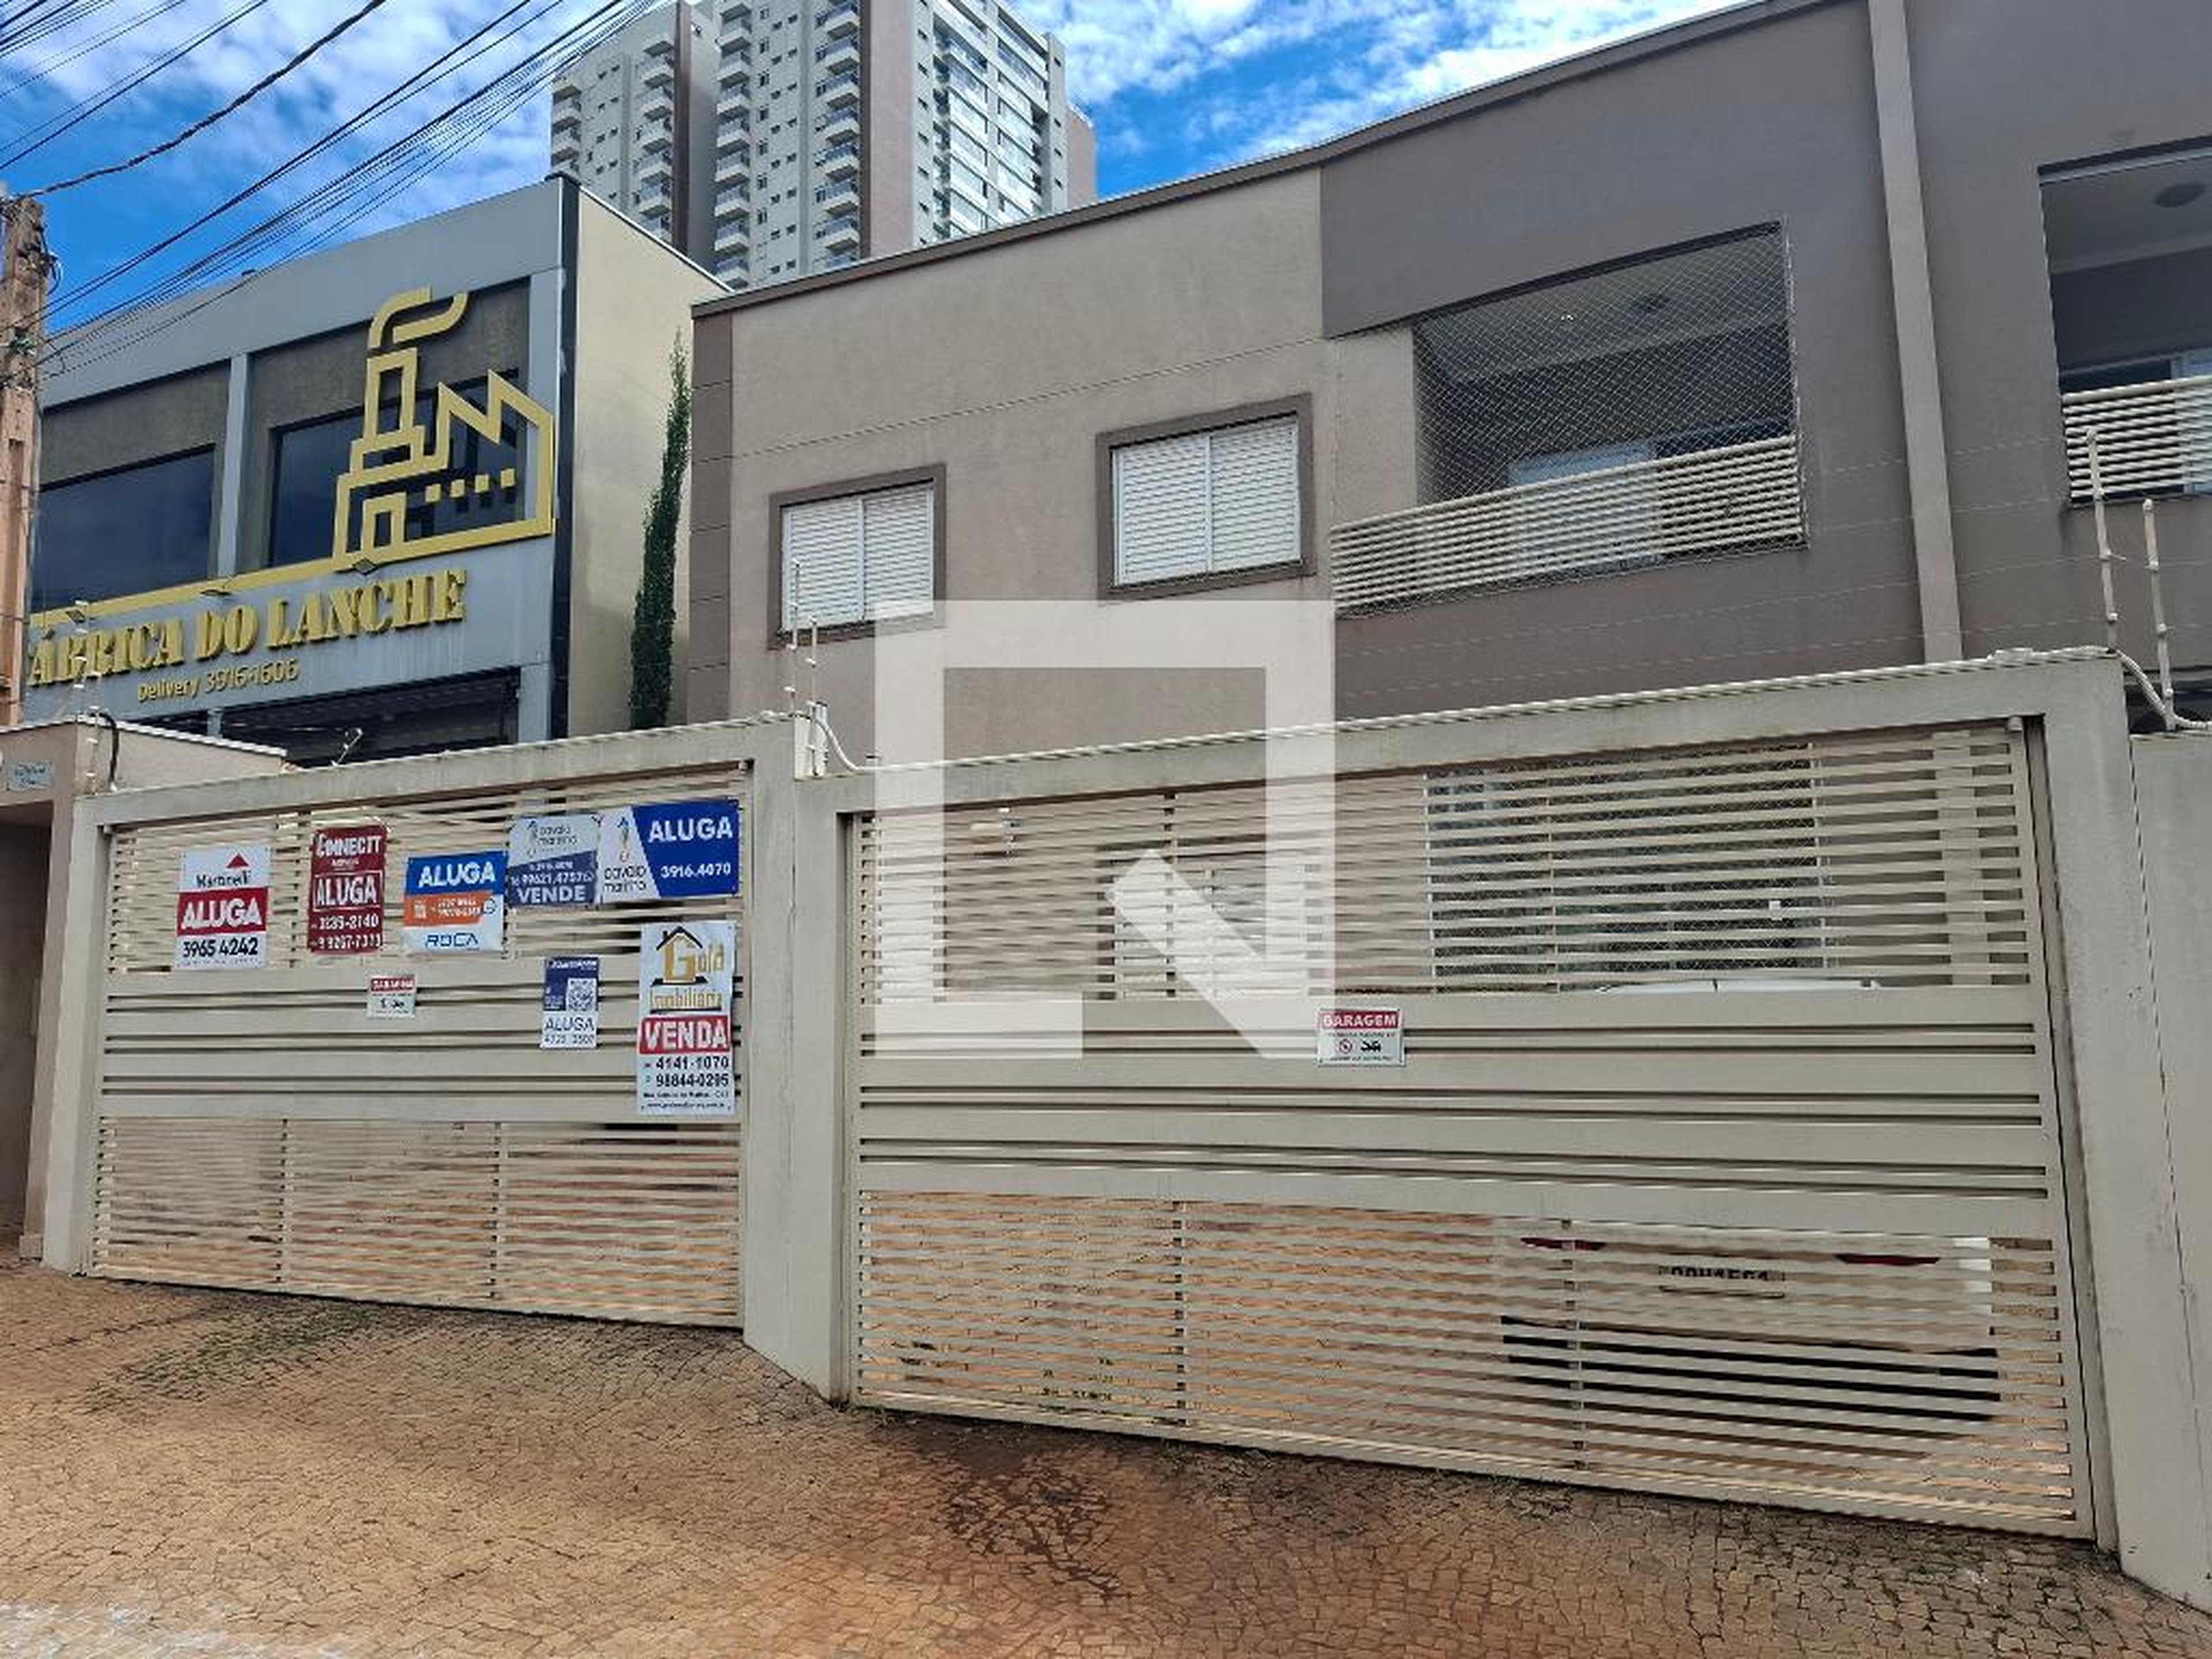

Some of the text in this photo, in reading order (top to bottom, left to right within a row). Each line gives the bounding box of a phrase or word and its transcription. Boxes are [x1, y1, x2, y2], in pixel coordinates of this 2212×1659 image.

[196, 602, 257, 661] DO
[267, 570, 467, 649] LANCHE
[138, 677, 199, 702] Delivery
[648, 816, 733, 843] ALUGA
[418, 861, 497, 888] ALUGA
[661, 862, 731, 878] 3916.4070
[316, 875, 377, 906] ALUGA
[517, 885, 586, 903] VENDE
[181, 896, 263, 930] ALUGA
[183, 937, 258, 958] 3965 4242
[425, 933, 478, 948] ROCA
[1323, 1014, 1397, 1028] GARAGEM
[643, 1020, 728, 1051] VENDA
[656, 1056, 729, 1070] 4141-1070
